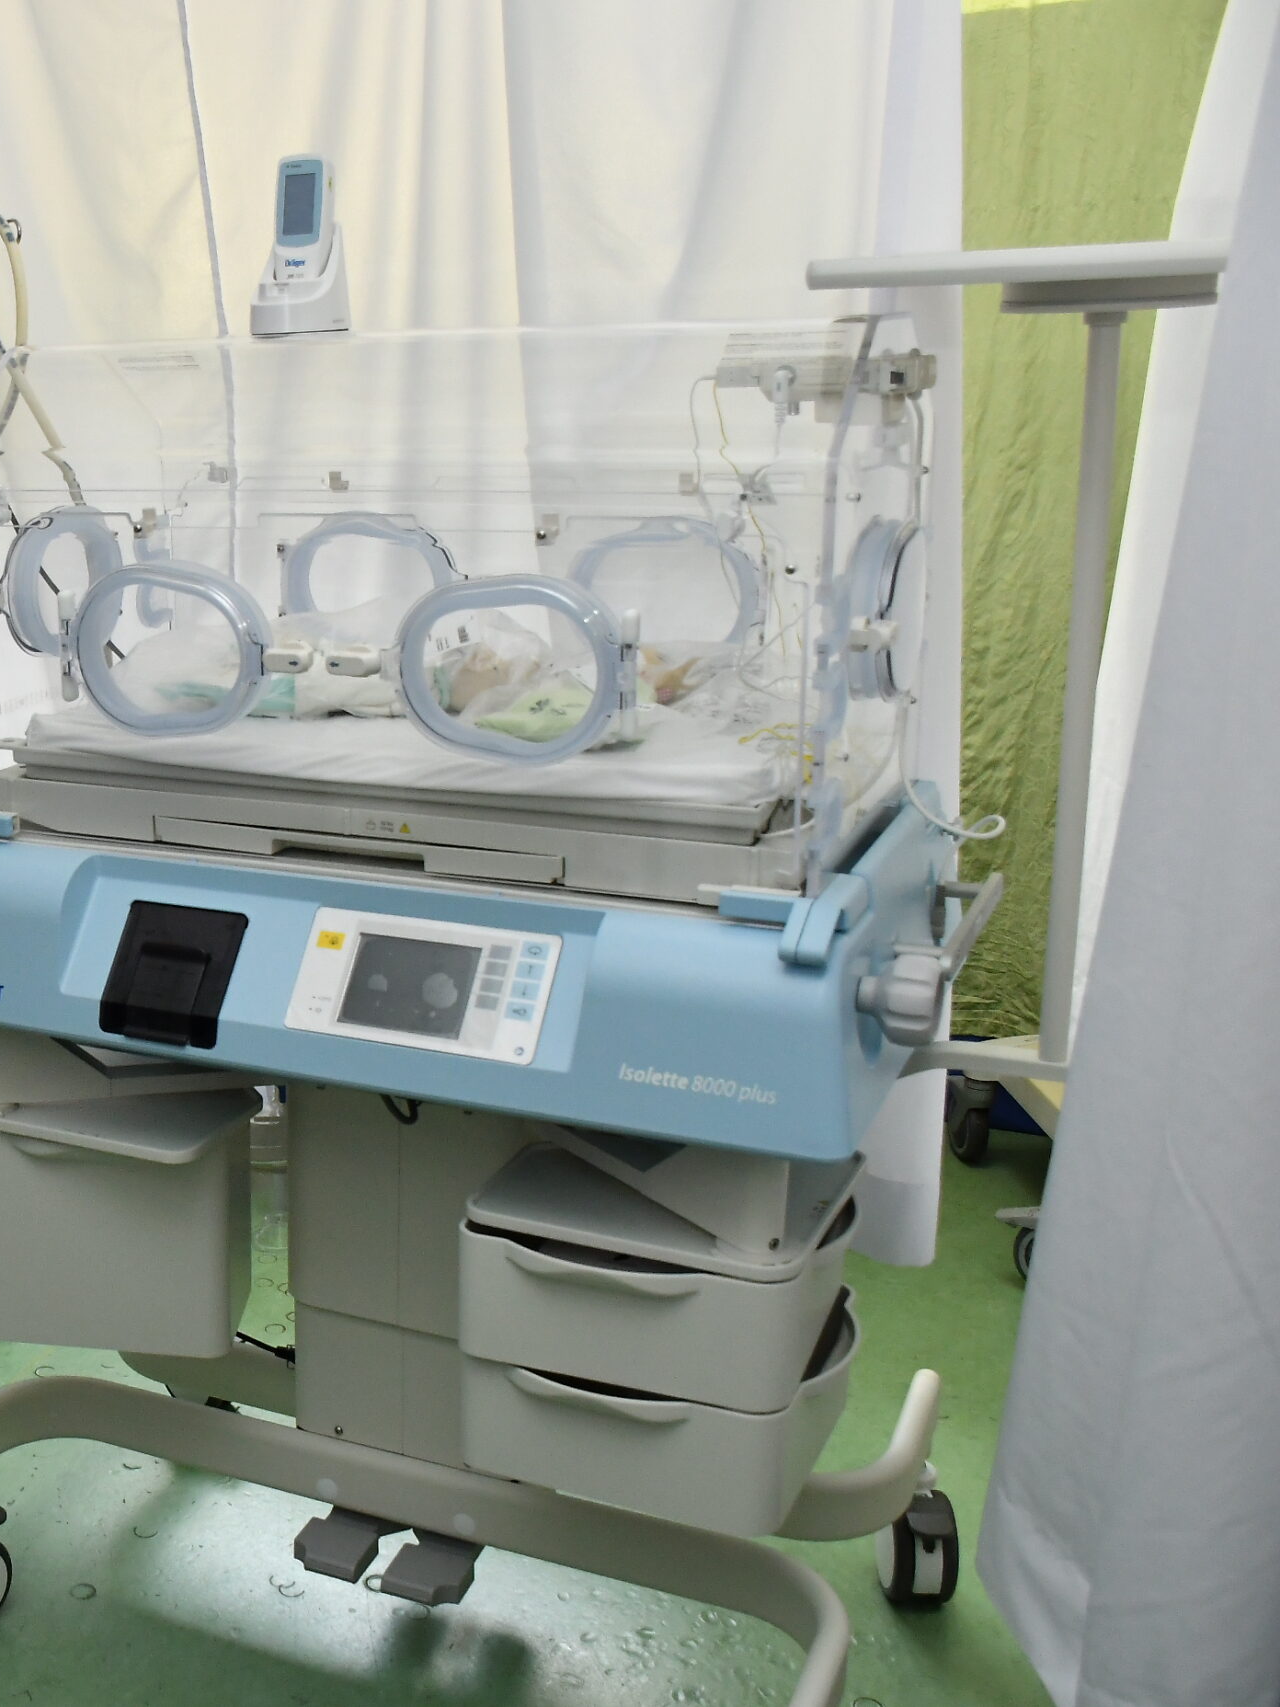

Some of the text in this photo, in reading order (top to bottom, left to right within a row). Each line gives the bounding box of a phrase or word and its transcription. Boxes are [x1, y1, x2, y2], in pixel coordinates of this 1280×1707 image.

[618, 1063, 778, 1105] Isolette 8000 plus
